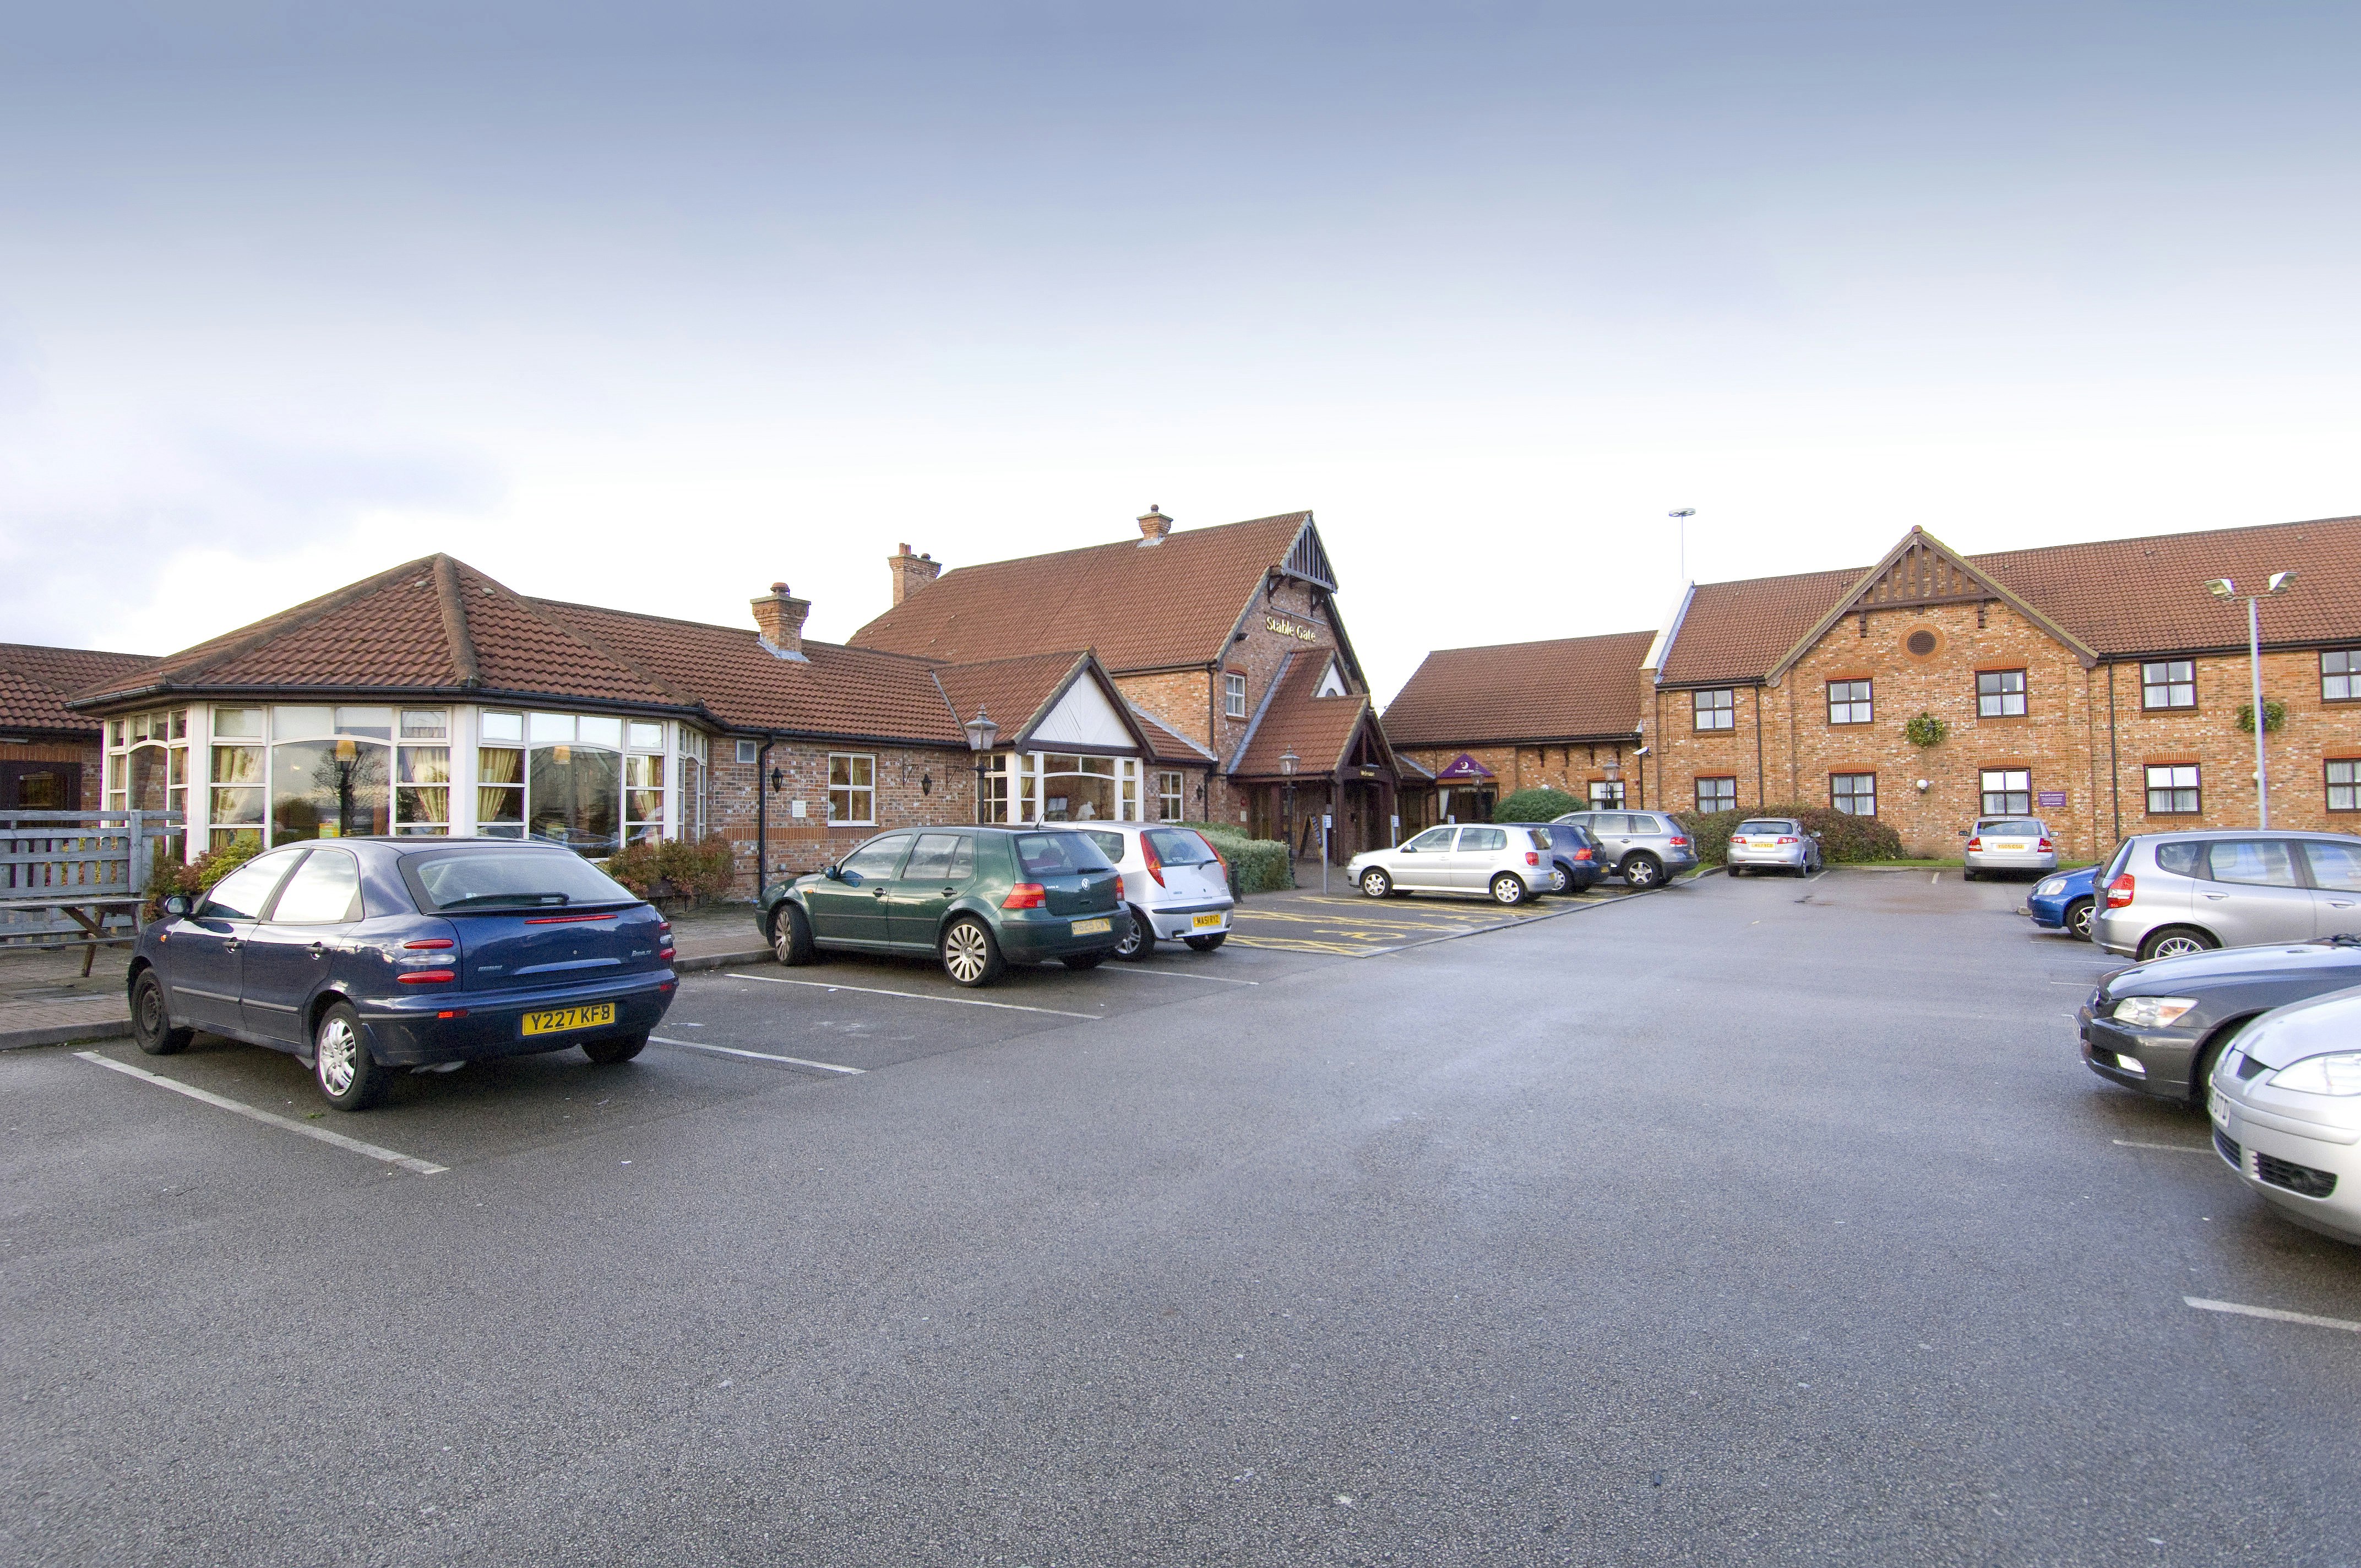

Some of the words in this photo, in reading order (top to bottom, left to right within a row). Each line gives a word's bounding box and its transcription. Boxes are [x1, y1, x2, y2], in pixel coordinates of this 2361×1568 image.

[1266, 616, 1294, 637] Stable
[1296, 624, 1316, 643] Gate
[531, 1010, 576, 1031] Y227
[580, 1004, 611, 1024] KFB
